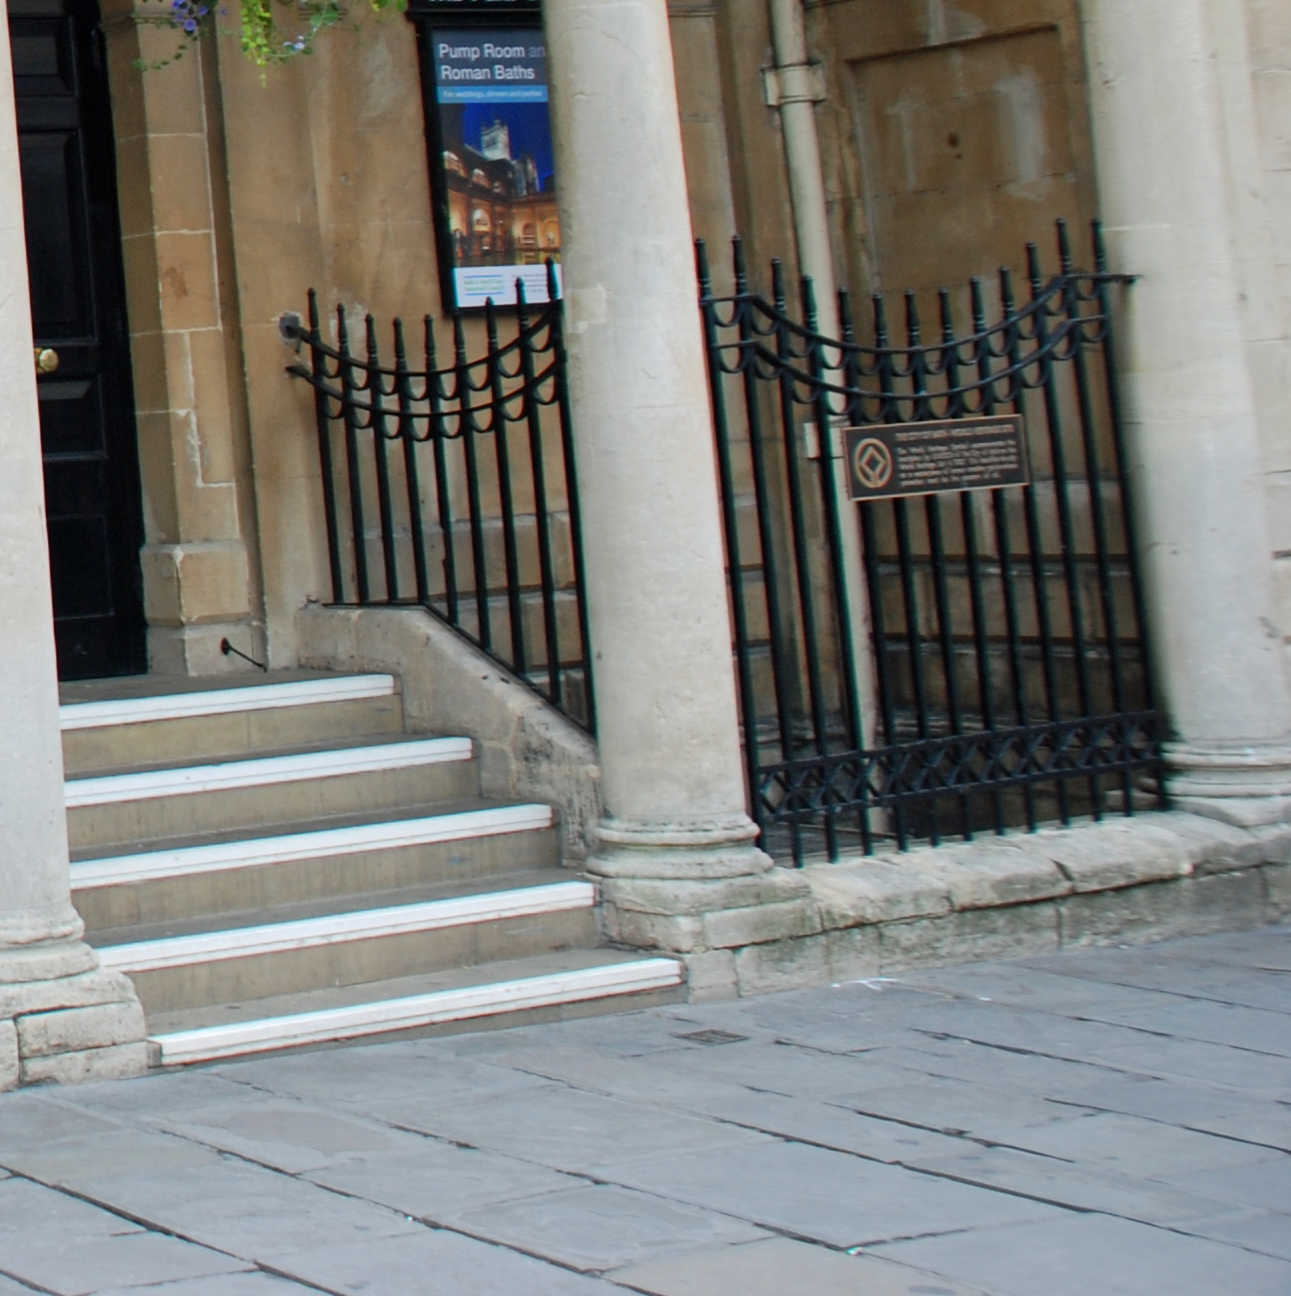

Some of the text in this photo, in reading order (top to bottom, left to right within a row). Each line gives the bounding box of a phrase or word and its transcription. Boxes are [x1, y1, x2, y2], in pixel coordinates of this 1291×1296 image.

[439, 43, 546, 61] Pump Room an
[441, 64, 535, 80] Roman Baths
